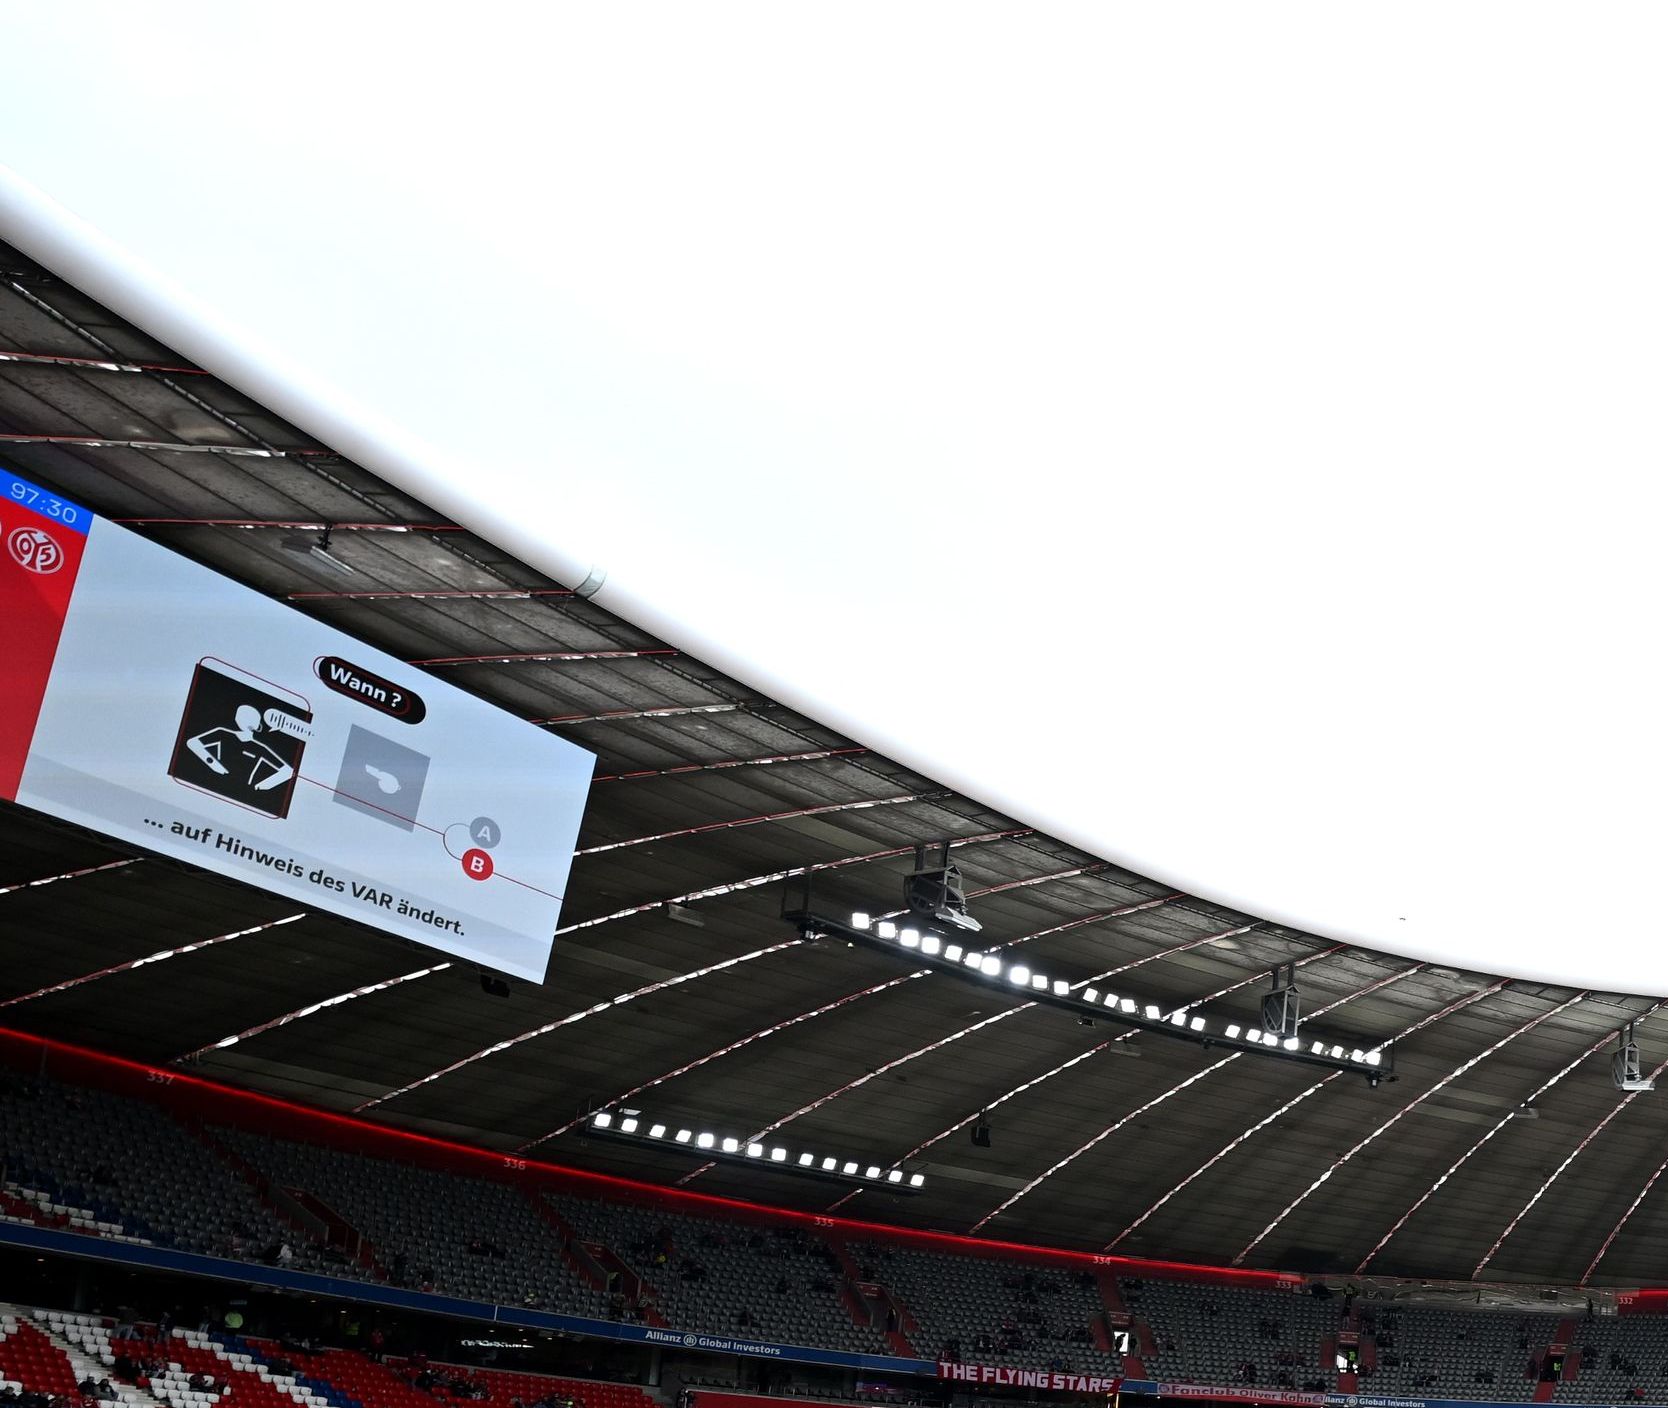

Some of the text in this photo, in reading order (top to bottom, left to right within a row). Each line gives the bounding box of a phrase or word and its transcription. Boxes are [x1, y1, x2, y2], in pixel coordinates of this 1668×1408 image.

[11, 482, 77, 524] 97:30
[330, 663, 387, 703] Wann
[477, 824, 493, 842] A
[170, 819, 466, 937] auf Hinweis des VAR ändert.
[470, 856, 484, 874] B
[698, 1337, 781, 1356] Global Investors
[939, 1361, 1114, 1394] THE FLYING STARS
[1171, 1384, 1312, 1404] Fanclub Oliver Kahn
